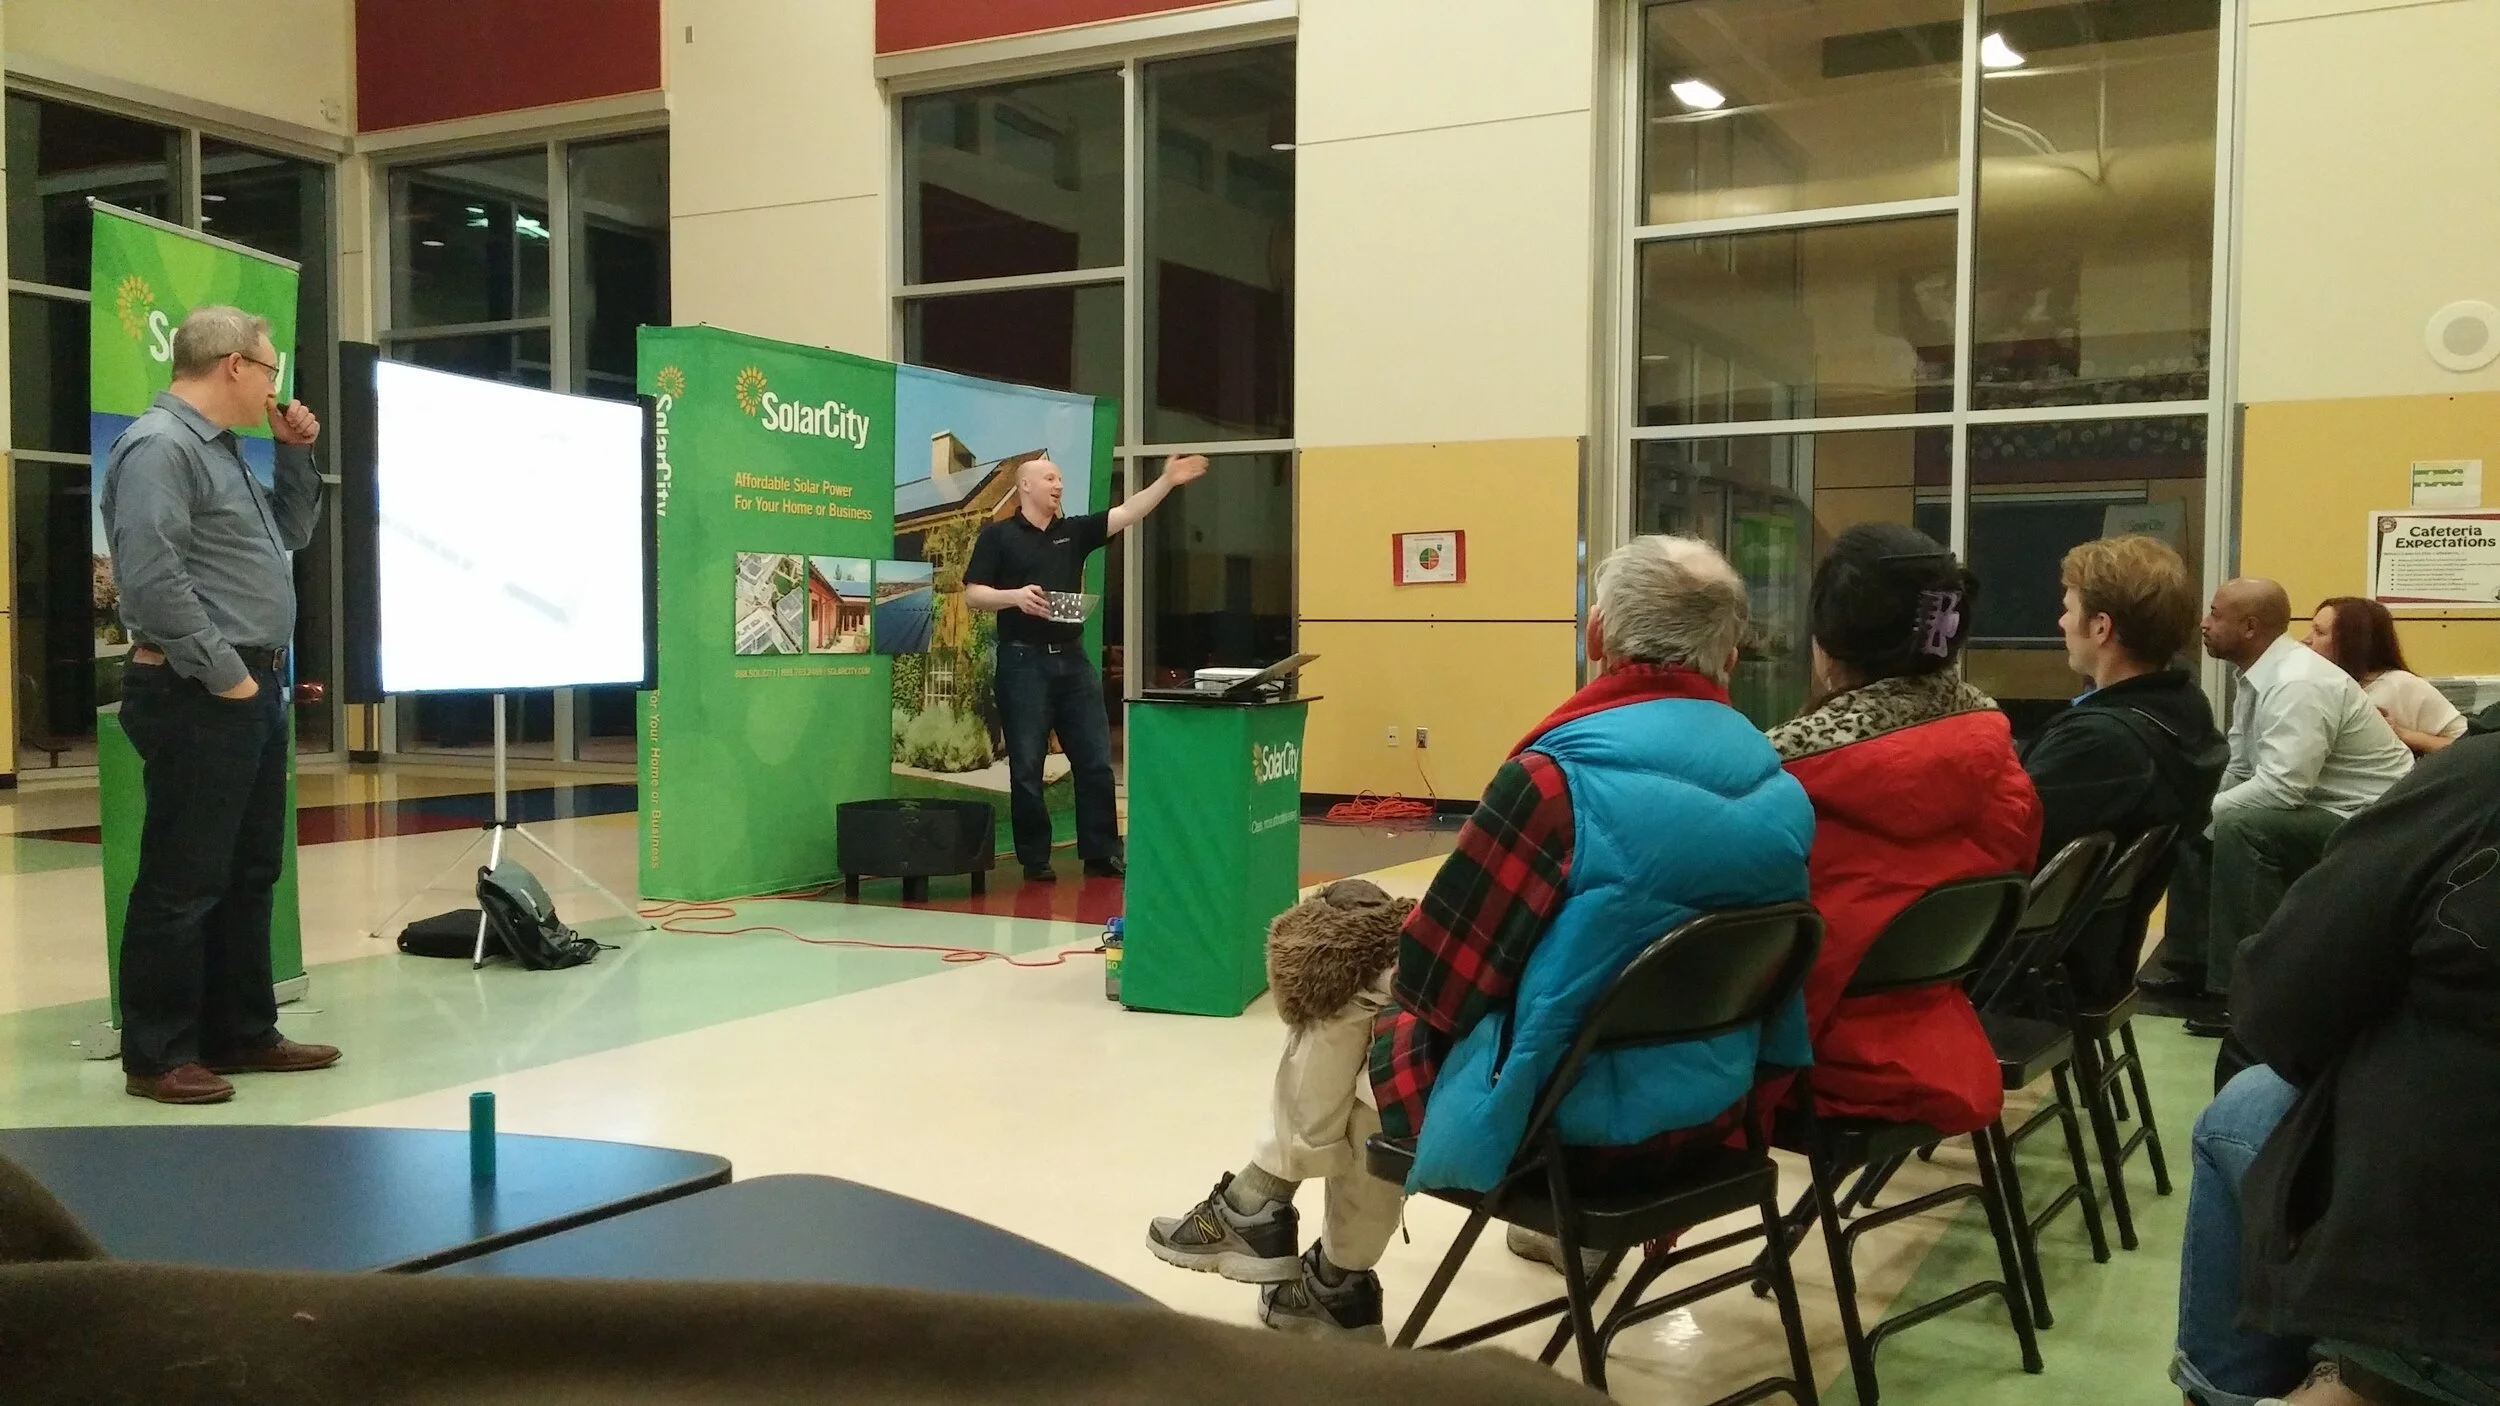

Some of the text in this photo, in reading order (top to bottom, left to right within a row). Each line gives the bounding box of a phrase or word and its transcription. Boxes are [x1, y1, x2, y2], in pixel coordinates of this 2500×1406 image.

[761, 391, 870, 450] SolarCity
[734, 471, 853, 498] Affordable Solar Power
[734, 494, 873, 521] For Your Home or Business
[2395, 536, 2497, 549] Expectations
[2409, 525, 2483, 538] Cafeteria
[650, 713, 660, 741] Your
[651, 747, 660, 787] Home
[1262, 741, 1300, 782] SolarCity
[651, 791, 660, 804] or
[651, 809, 662, 869] Business
